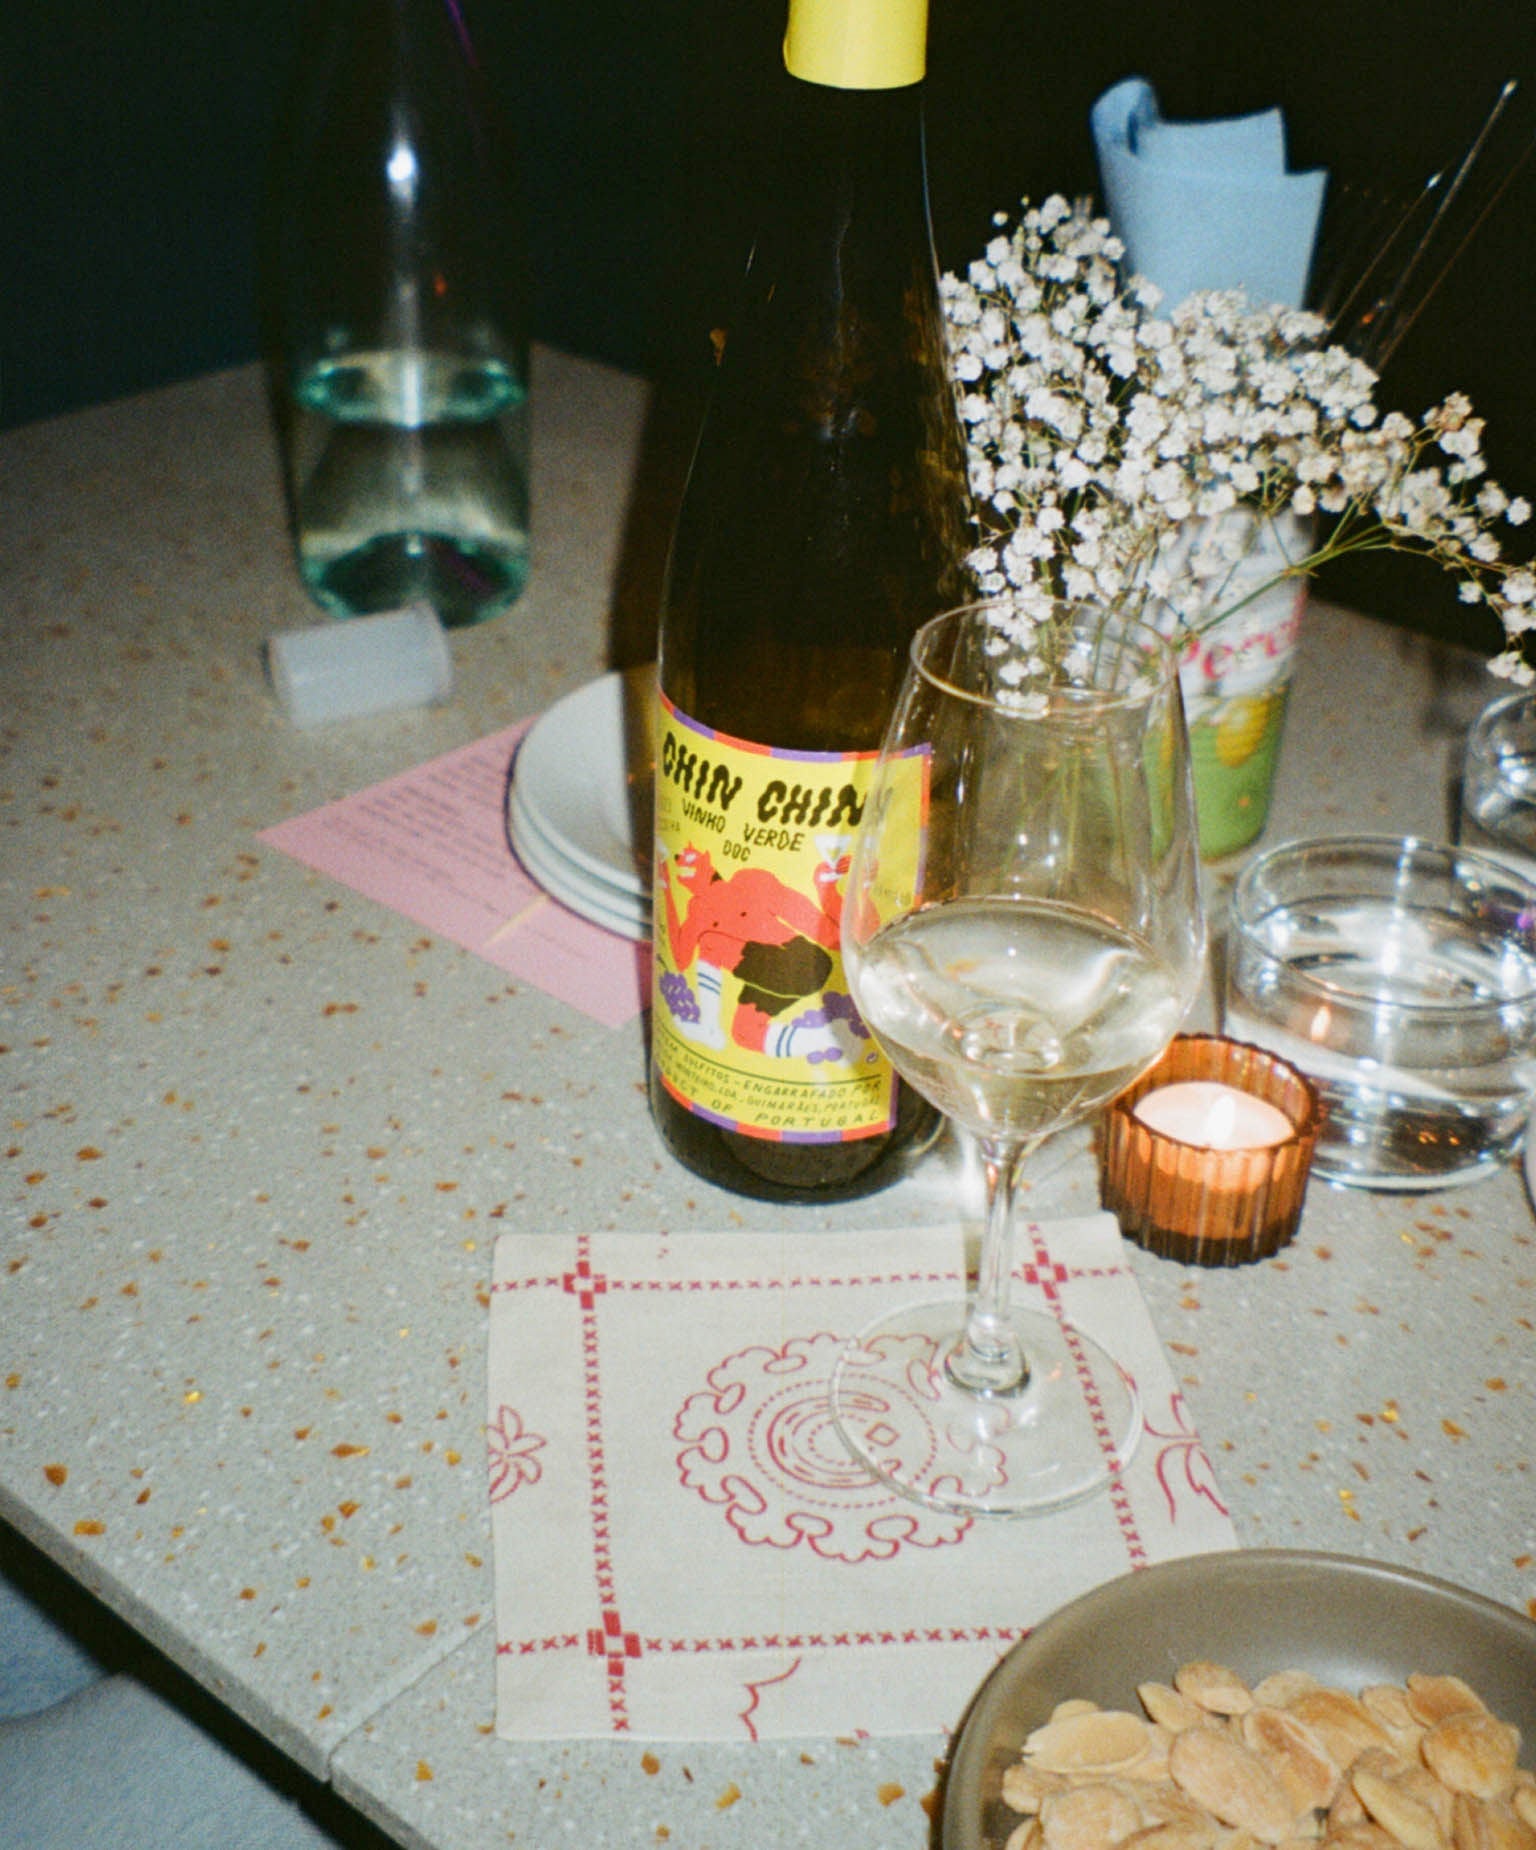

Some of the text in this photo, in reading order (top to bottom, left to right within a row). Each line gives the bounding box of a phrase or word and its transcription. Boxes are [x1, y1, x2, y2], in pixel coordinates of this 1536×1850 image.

[662, 731, 893, 828] CHIN CHIN
[682, 798, 726, 834] VINHO
[744, 822, 805, 852] VERDE
[722, 840, 752, 863] DOC
[743, 1080, 847, 1098] ENGARRAFADO
[711, 1098, 733, 1113] OF
[753, 1110, 880, 1128] PORTUGAL
